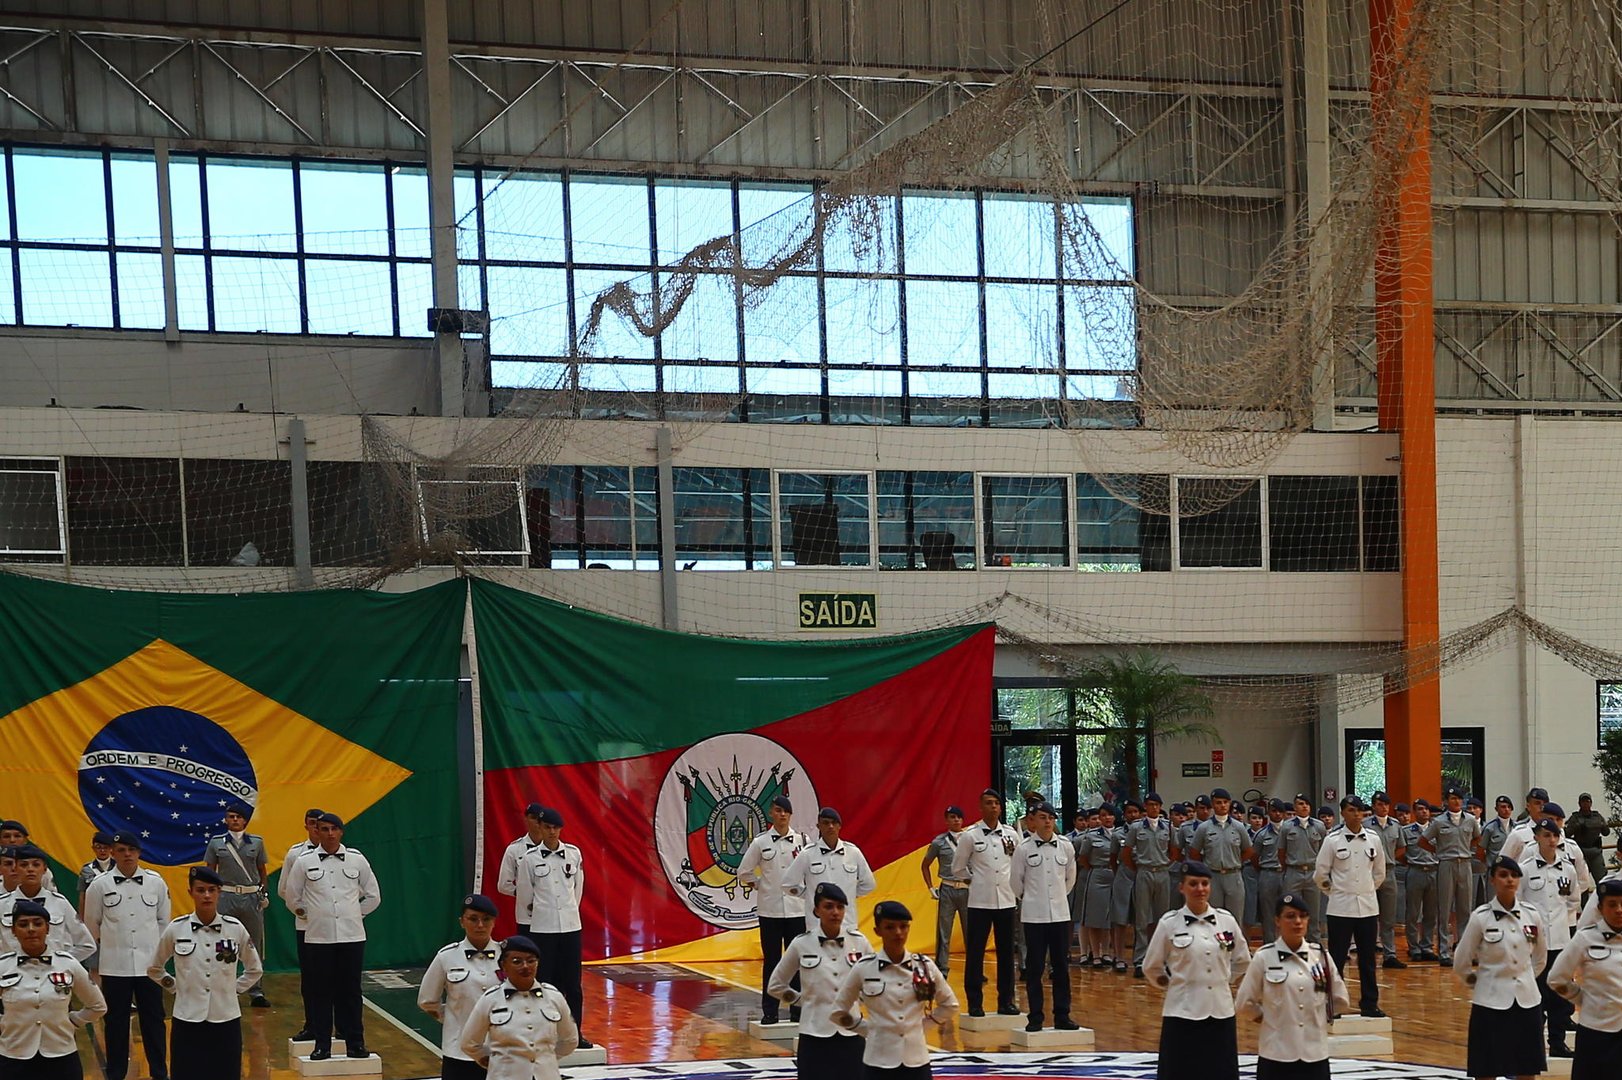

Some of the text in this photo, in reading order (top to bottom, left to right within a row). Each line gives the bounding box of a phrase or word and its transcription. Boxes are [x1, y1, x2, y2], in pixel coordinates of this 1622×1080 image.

[800, 594, 875, 625] SAÍDA
[86, 753, 251, 797] ORDEM E PROGRESSO
